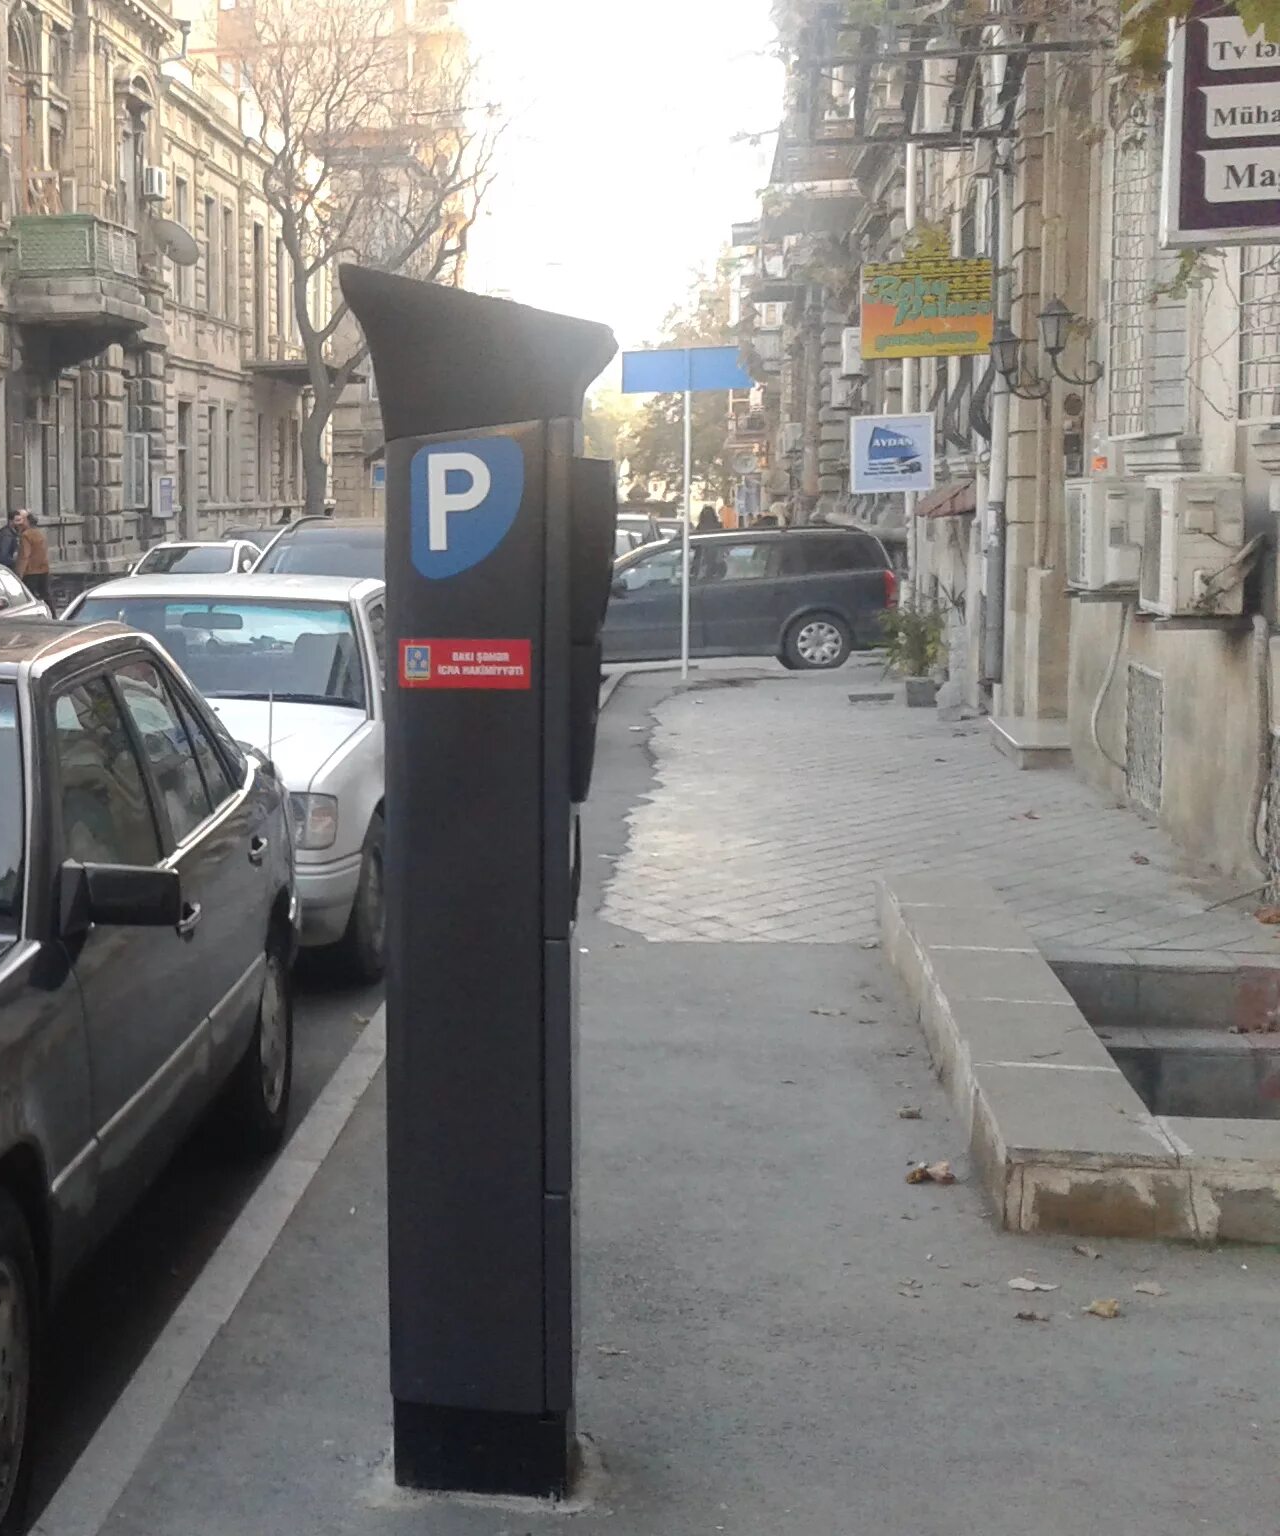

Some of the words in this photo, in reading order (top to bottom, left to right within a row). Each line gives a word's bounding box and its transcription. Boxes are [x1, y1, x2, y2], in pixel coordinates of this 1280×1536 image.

[1212, 40, 1248, 61] Tv
[1255, 40, 1280, 58] tə
[1221, 162, 1280, 192] Ma
[872, 437, 913, 448] AYDAN
[427, 452, 491, 551] P
[451, 651, 475, 662] BAKI
